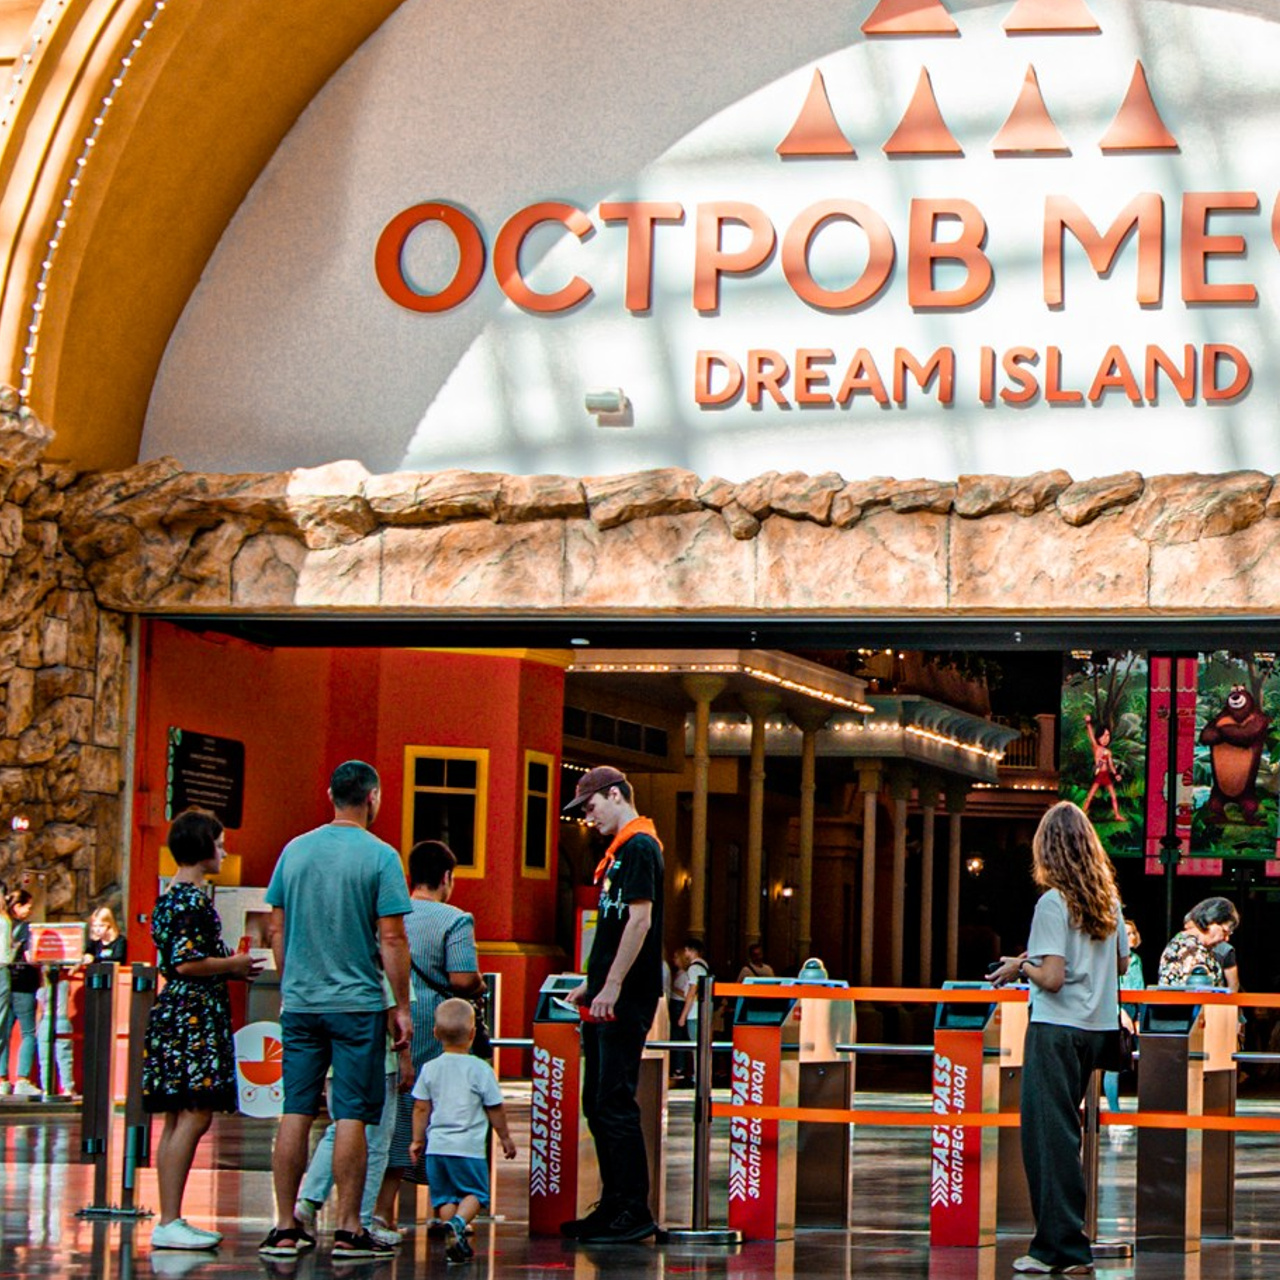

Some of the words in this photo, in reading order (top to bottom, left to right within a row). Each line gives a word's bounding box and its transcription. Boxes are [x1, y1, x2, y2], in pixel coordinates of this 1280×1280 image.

[373, 194, 995, 316] ОСТРОВ
[693, 346, 955, 408] DREAM
[979, 342, 1253, 405] ISLAND
[531, 1045, 551, 1174] FASTPASS
[549, 1056, 566, 1195] ЭКСПРЕСС-ВХОД
[748, 1059, 766, 1199] ЭКСПРЕССВХОД
[950, 1063, 968, 1204] ЭКСПРЕС-ВХОД
